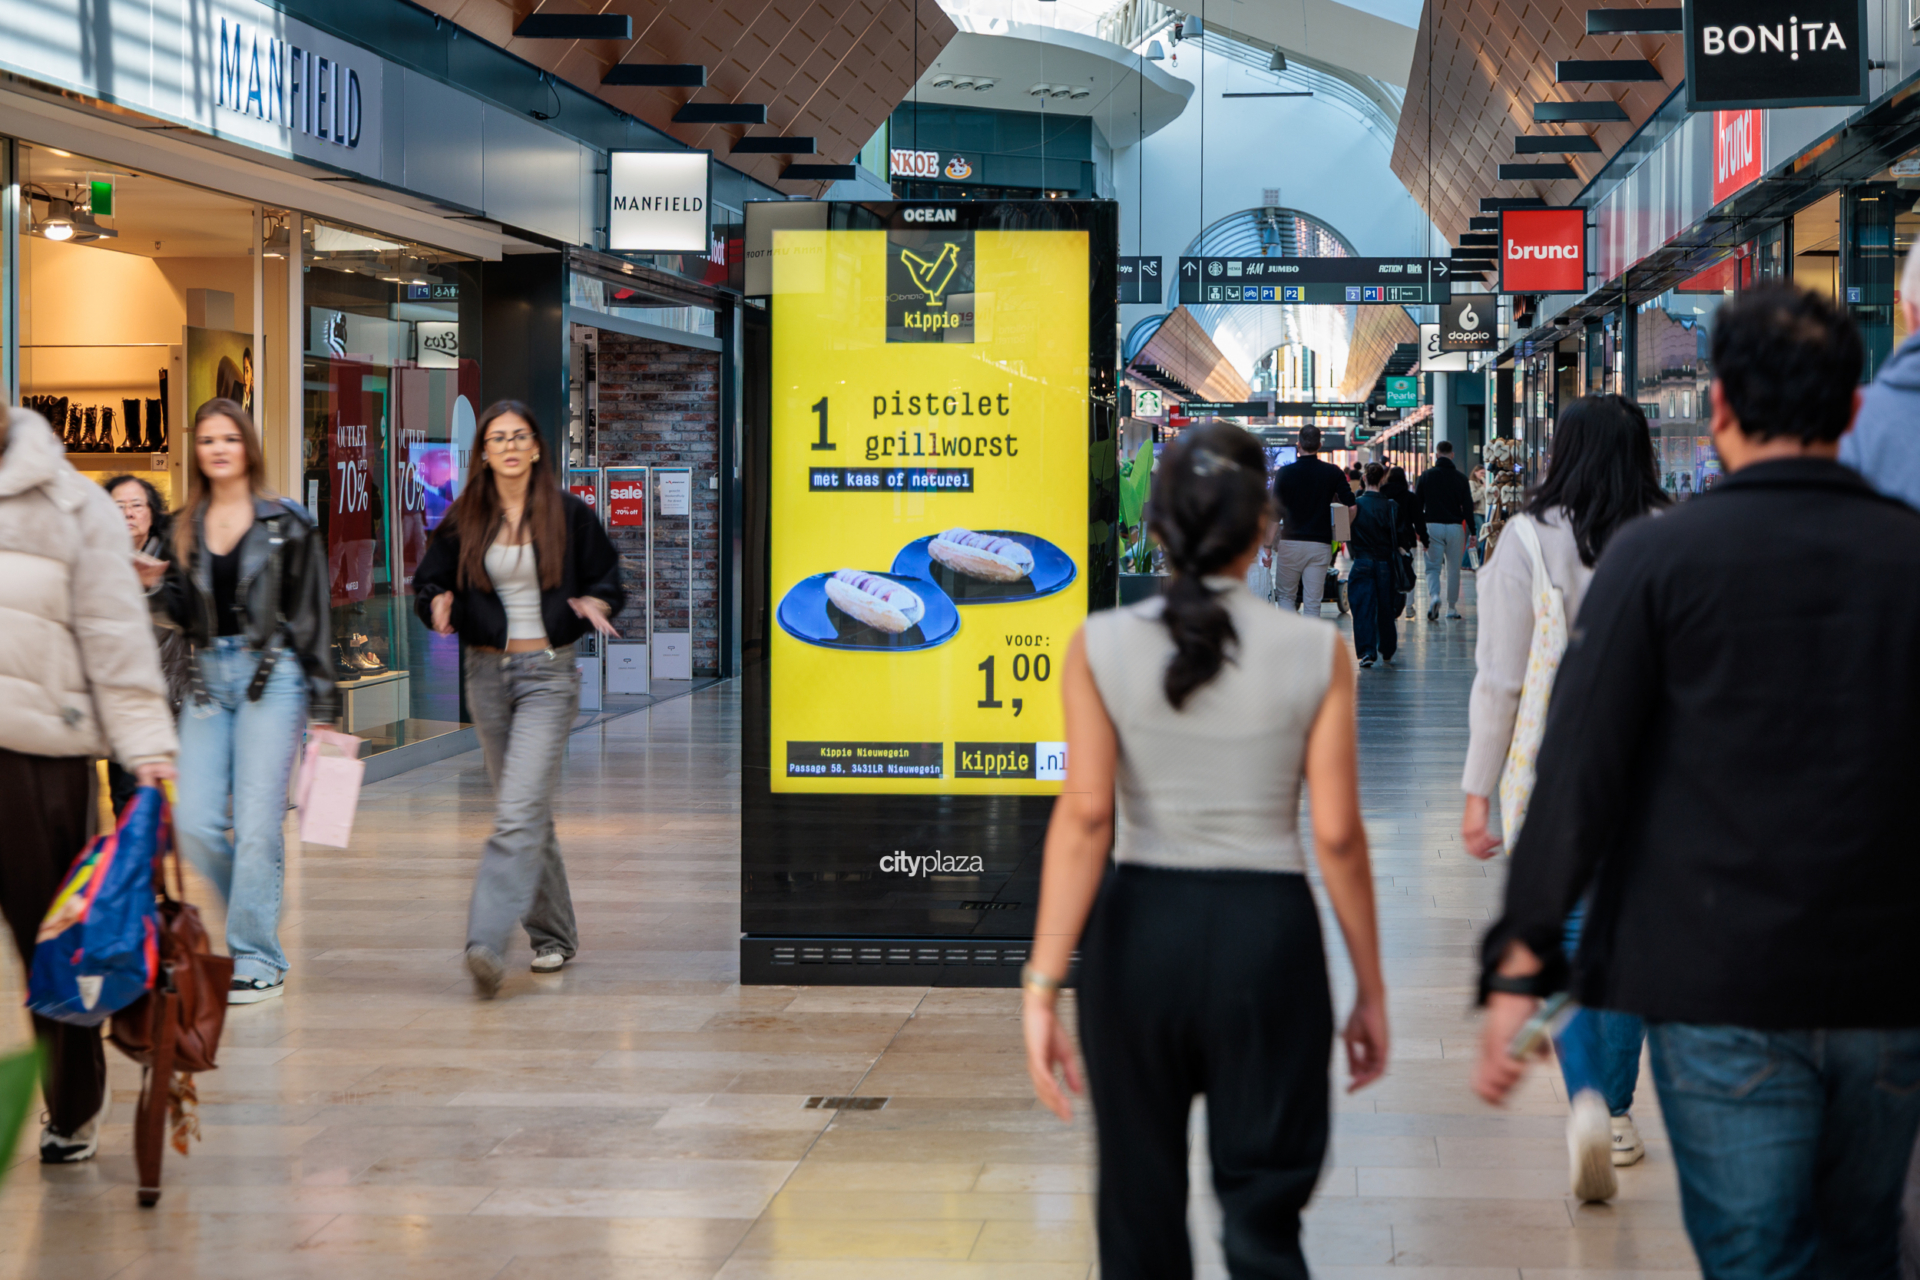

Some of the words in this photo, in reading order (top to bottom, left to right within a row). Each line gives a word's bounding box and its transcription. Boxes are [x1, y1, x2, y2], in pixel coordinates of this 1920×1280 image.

[216, 16, 362, 149] MANFIELD
[891, 150, 939, 177] NKOE
[613, 194, 703, 213] MANFIELD
[904, 208, 957, 222] OCEAN
[1507, 239, 1579, 261] bruna
[1120, 265, 1133, 274] oys
[1267, 265, 1300, 273] JUMBO
[1406, 264, 1422, 274] Dirk
[1263, 289, 1274, 298] P1
[1286, 289, 1298, 299] P2
[1365, 290, 1376, 298] P1
[904, 311, 960, 333] kippie
[1448, 331, 1490, 341] doppio
[873, 389, 1010, 420] pistolet
[1387, 391, 1416, 400] Pearle
[811, 396, 837, 451] 1
[337, 425, 367, 448] OUTLET
[399, 428, 426, 450] OUTLET
[865, 430, 1019, 461] grillworst
[337, 460, 369, 514] 70%
[398, 461, 426, 511] 70%
[813, 472, 839, 487] met
[847, 471, 880, 487] kaas
[888, 472, 905, 487] of
[912, 472, 971, 488] naturel
[1006, 633, 1051, 647] voor:
[820, 747, 853, 759] Kippie
[857, 747, 910, 759] Nieuwegein
[789, 763, 826, 775] Passage
[831, 764, 846, 775] 58,
[851, 764, 884, 775] 3431LR
[888, 764, 941, 775] Nieuwegein
[879, 850, 984, 877] cityplaza
